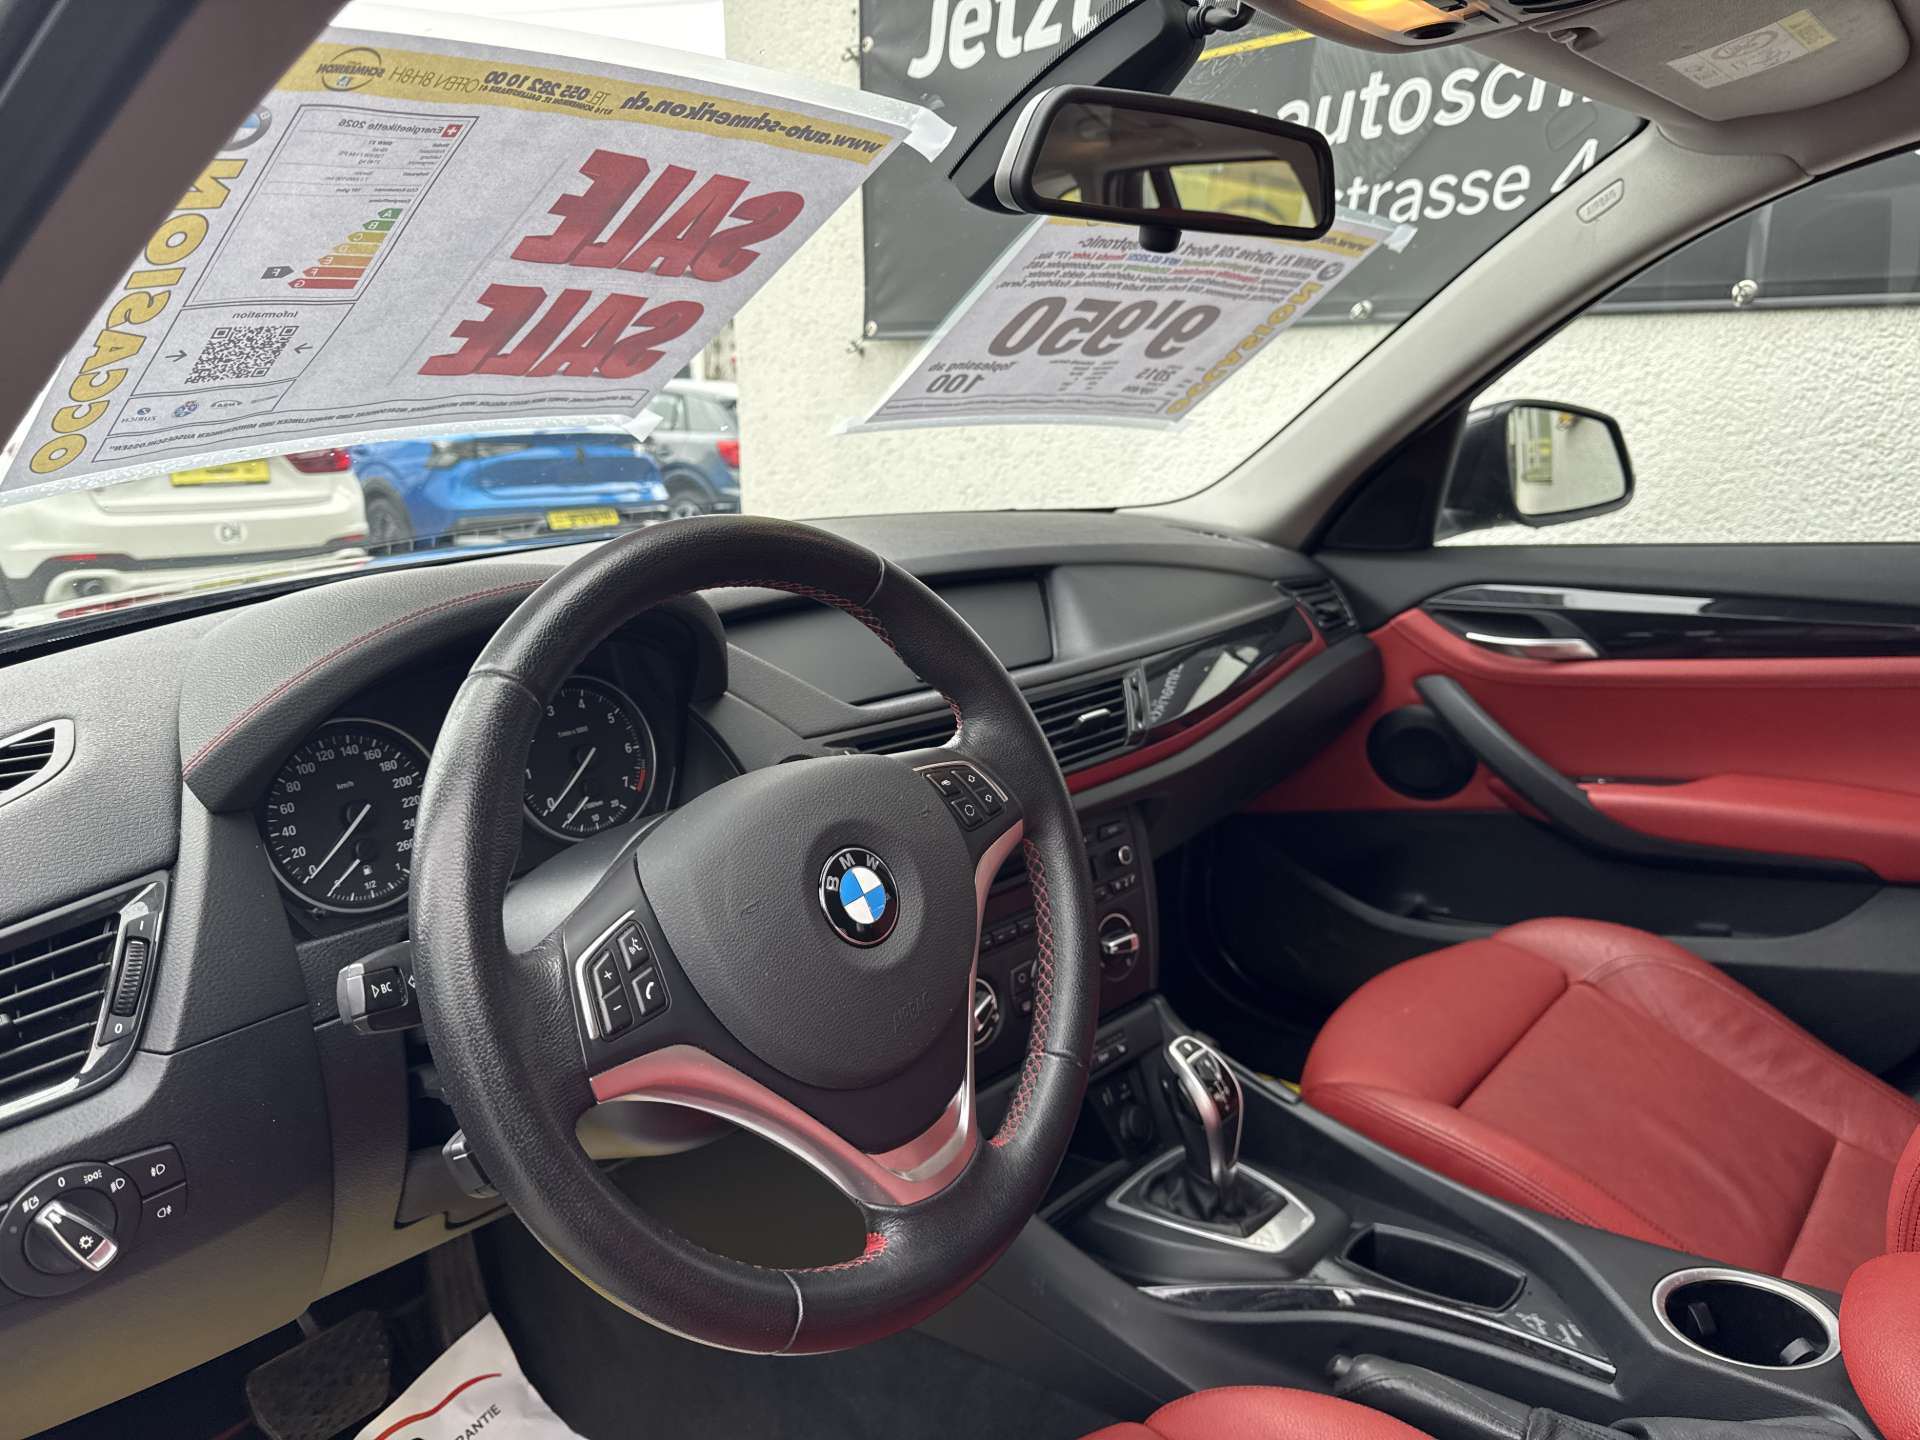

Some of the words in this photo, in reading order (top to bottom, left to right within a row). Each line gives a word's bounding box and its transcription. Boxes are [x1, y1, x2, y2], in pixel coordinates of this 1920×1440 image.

[1334, 163, 1531, 223] trasse
[578, 699, 586, 709] 4
[547, 705, 555, 717] 3
[607, 712, 616, 724] 5
[340, 744, 359, 757] 140
[624, 742, 632, 753] 6
[316, 749, 335, 762] 120
[363, 748, 382, 762] 160
[296, 762, 316, 775] 100
[379, 759, 398, 772] 180
[525, 768, 532, 779] 1
[286, 780, 301, 793] 80
[392, 775, 413, 789] 200
[622, 776, 629, 788] 7
[280, 802, 295, 814] 60
[402, 795, 421, 808] 220
[547, 797, 555, 809] 0
[403, 818, 415, 830] 24
[281, 825, 296, 838] 40
[291, 845, 306, 859] 20
[308, 864, 317, 877] 0
[826, 852, 879, 892] BMW
[380, 981, 393, 994] BC
[58, 1176, 66, 1188] 0
